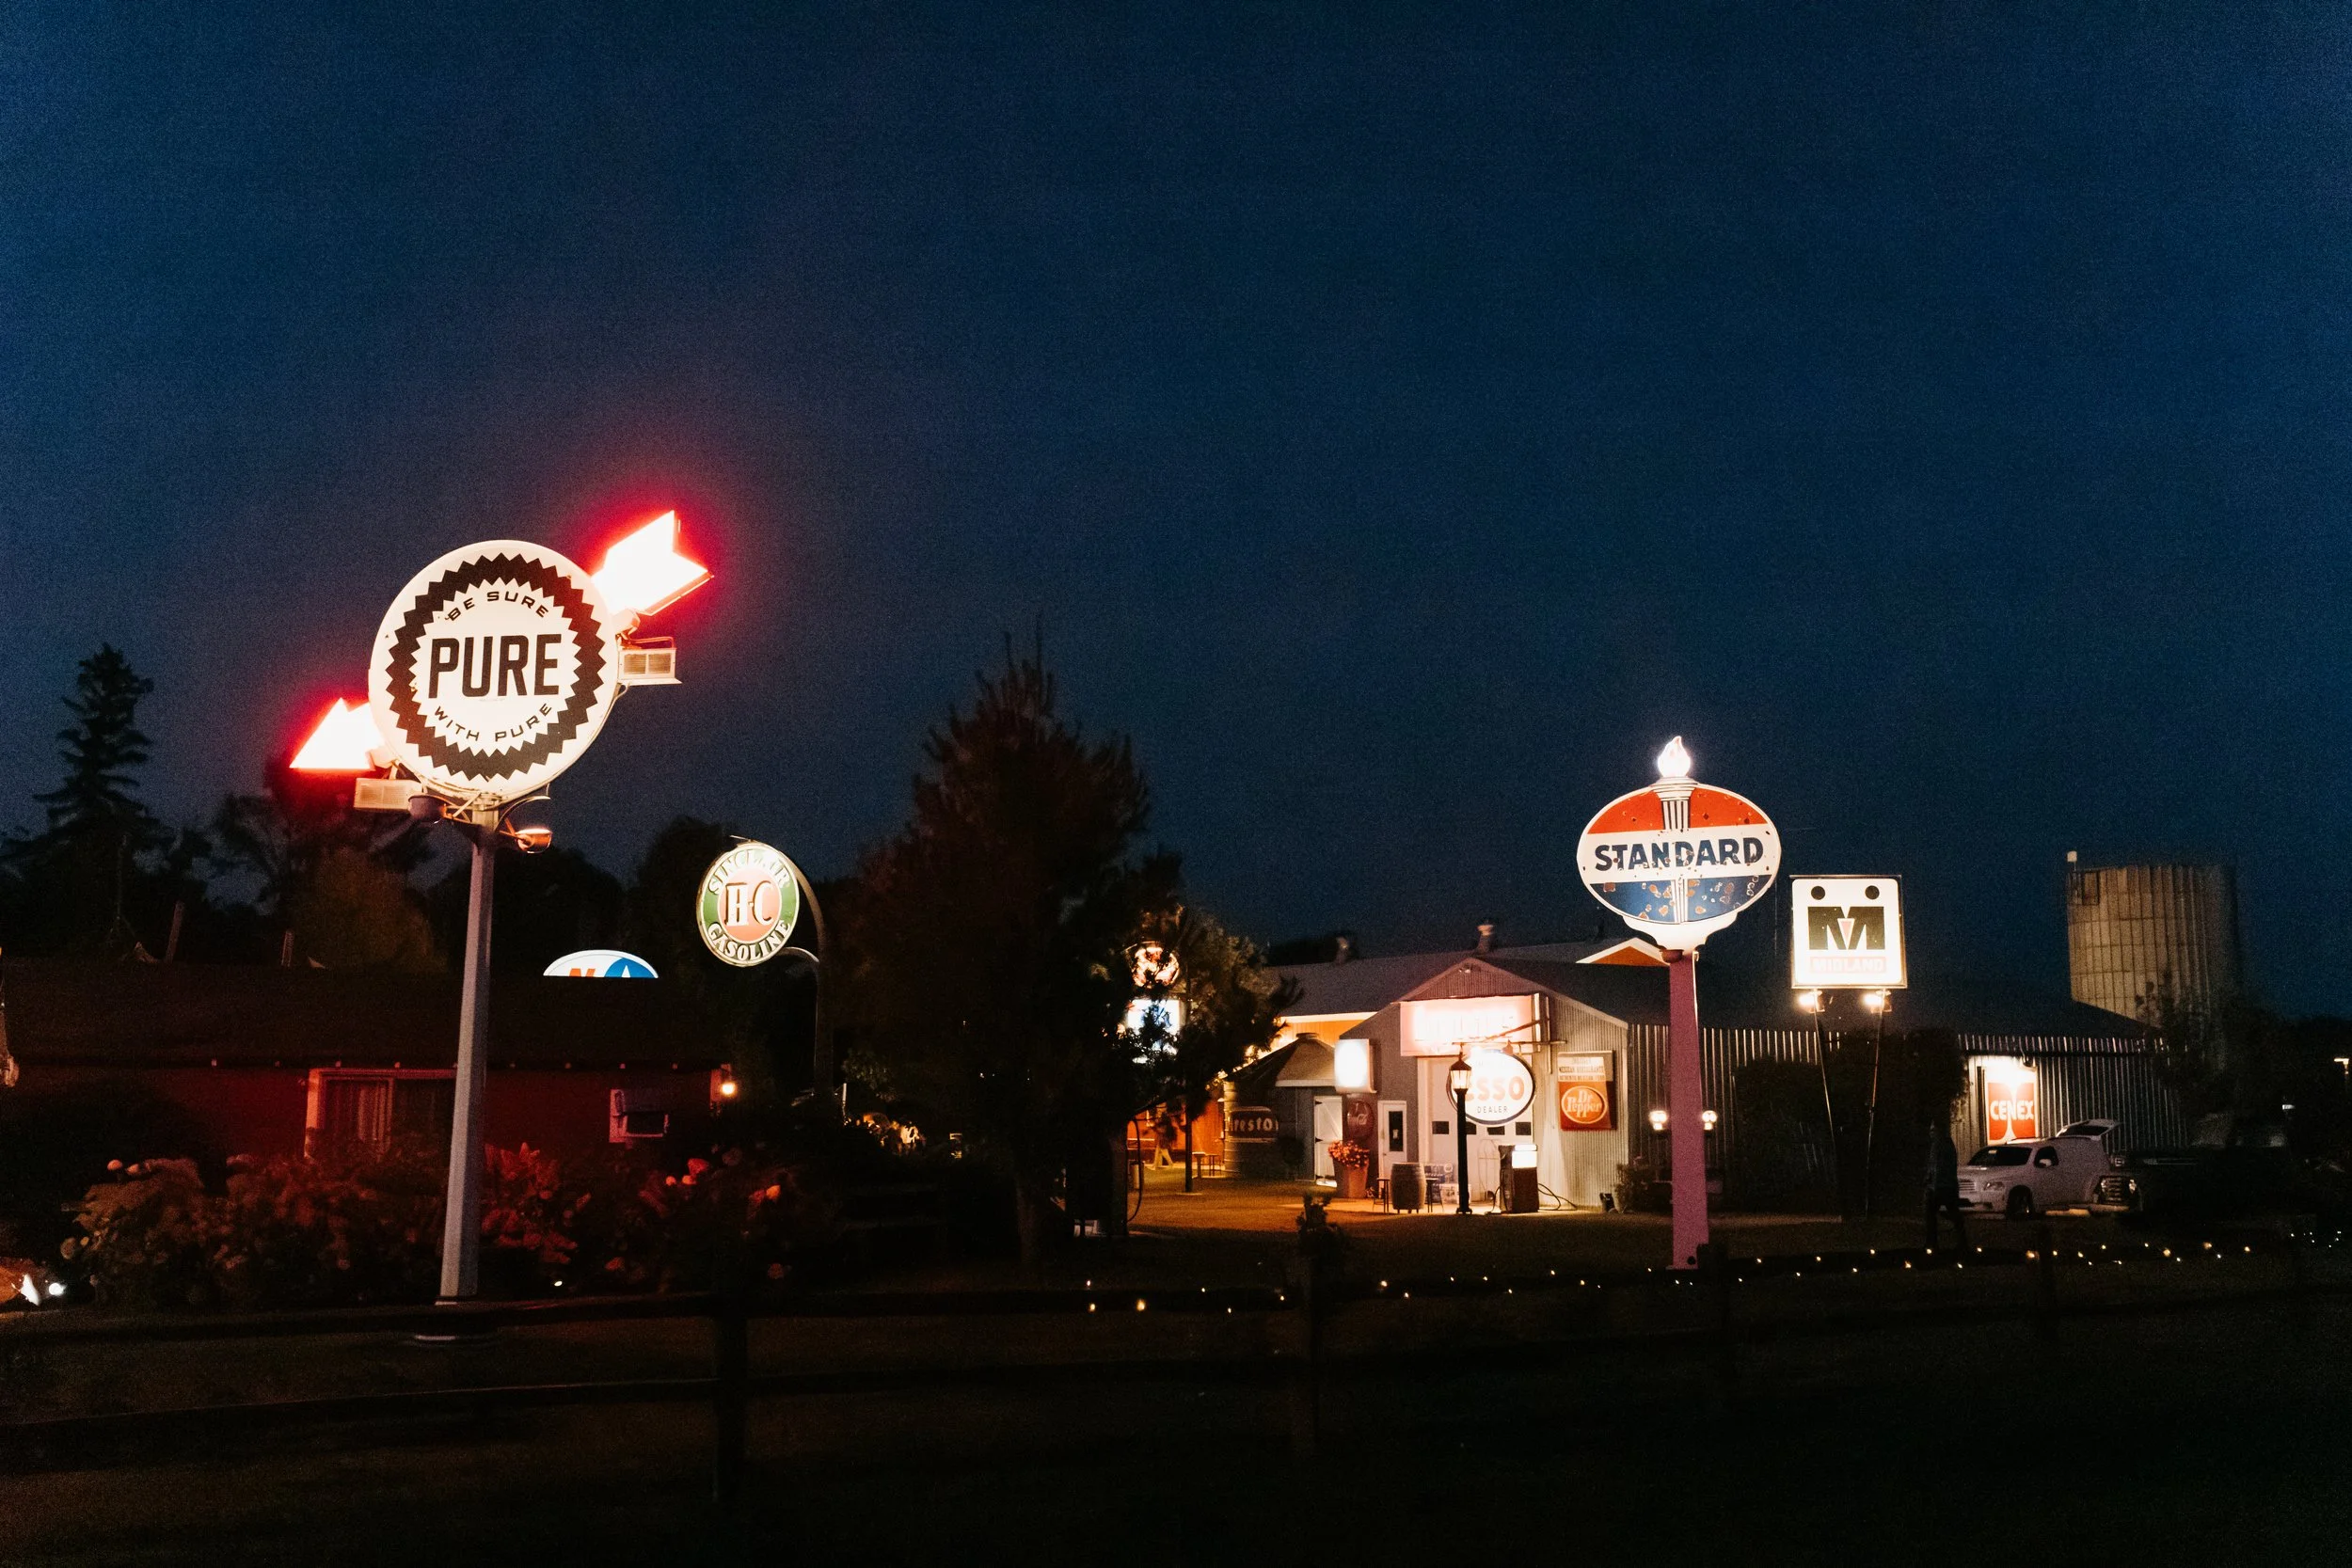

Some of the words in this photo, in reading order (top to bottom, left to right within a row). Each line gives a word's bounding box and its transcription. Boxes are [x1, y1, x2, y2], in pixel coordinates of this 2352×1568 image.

[446, 597, 476, 621] BE
[487, 591, 548, 618] SURE
[428, 634, 562, 699] PURE
[435, 705, 480, 741] WITH
[495, 703, 552, 742] PURE
[1595, 837, 1764, 871] STANDARD
[707, 919, 791, 960] GASOLINE
[1476, 1105, 1508, 1114] DEALER
[1566, 1096, 1600, 1118] Pepper
[1990, 1100, 2034, 1121] CENEX
